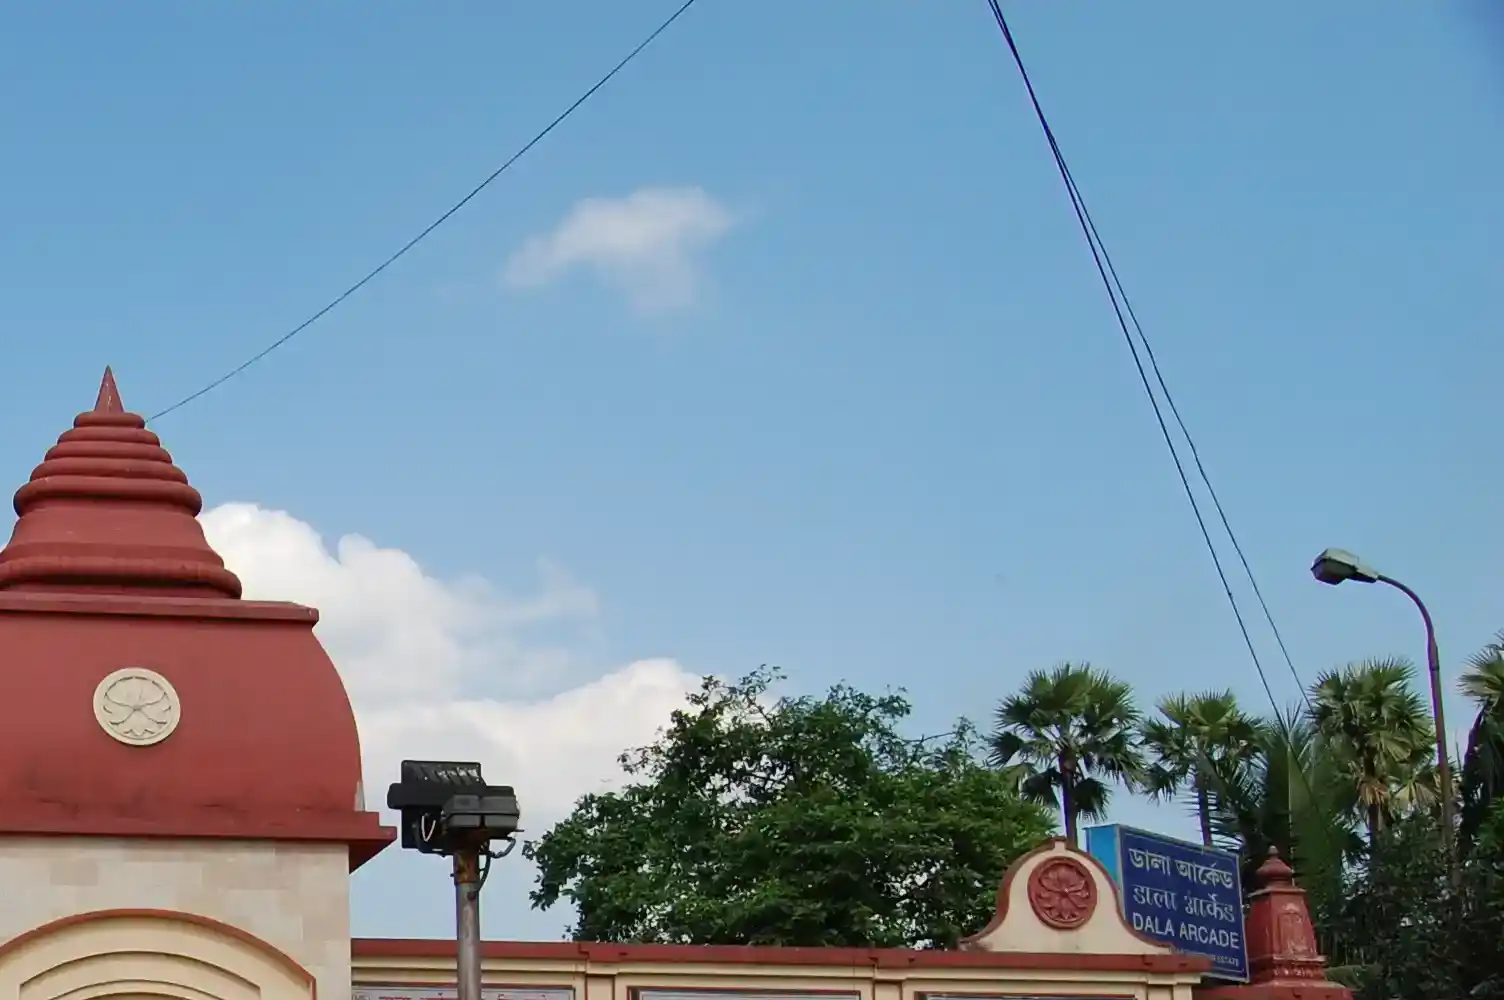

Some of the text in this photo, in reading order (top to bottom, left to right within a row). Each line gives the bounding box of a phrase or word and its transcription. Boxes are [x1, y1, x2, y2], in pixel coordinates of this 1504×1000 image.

[1129, 848, 1234, 890] ডালা আর্কেড
[1131, 884, 1178, 911] डाला
[1132, 912, 1240, 950] DALA ARCADE
